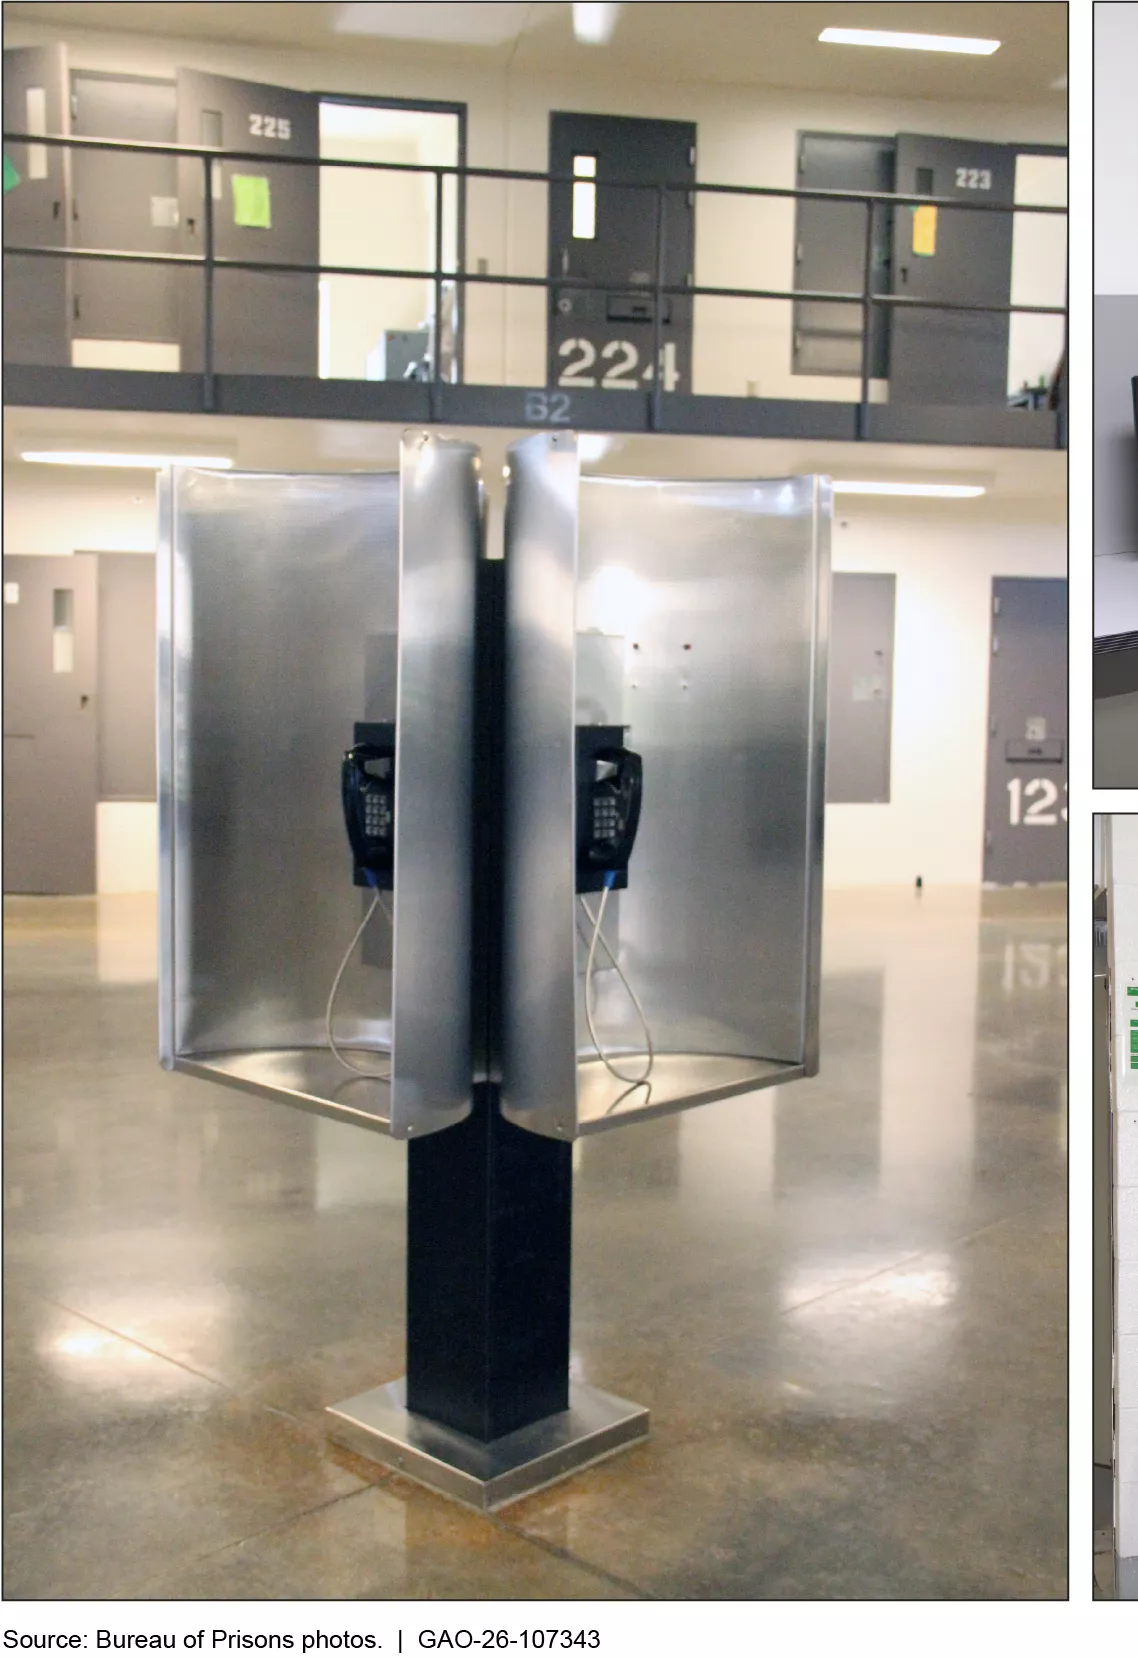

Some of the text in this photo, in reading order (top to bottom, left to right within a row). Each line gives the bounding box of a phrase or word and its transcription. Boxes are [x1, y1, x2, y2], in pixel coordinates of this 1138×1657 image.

[249, 113, 291, 140] 225
[956, 167, 992, 190] 223
[558, 338, 680, 392] 224
[1007, 777, 1067, 826] 12
